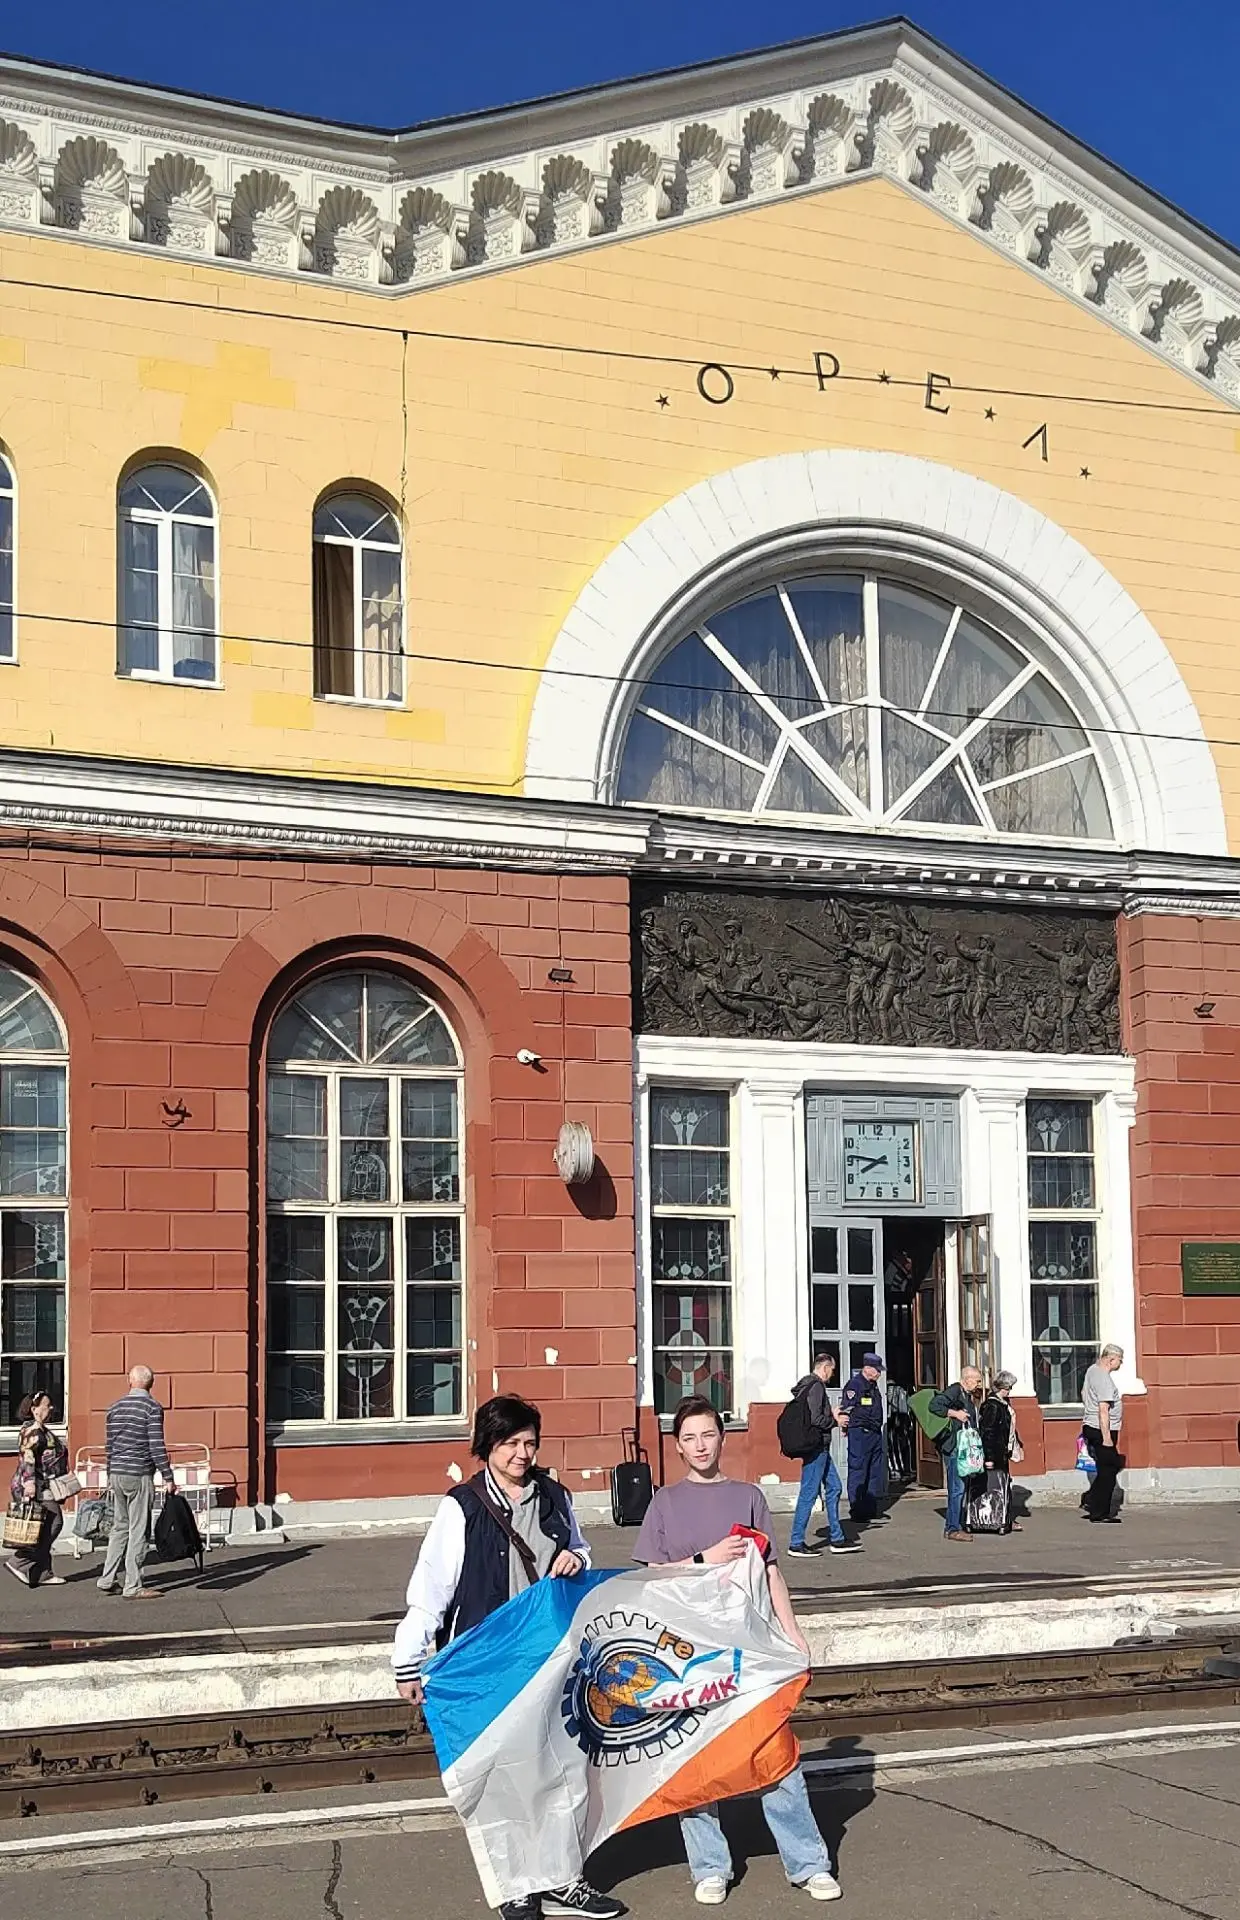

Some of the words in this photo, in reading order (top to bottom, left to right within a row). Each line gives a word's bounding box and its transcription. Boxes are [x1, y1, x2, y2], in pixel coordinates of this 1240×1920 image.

[858, 1124, 865, 1135] 11
[873, 1124, 883, 1136] 12
[892, 1124, 896, 1136] 1
[844, 1137, 854, 1149] 10
[903, 1138, 909, 1149] 2
[847, 1156, 854, 1166] 9
[903, 1156, 910, 1167] 3
[847, 1173, 854, 1184] 8
[904, 1174, 911, 1184] 4
[860, 1187, 865, 1197] 7
[876, 1187, 882, 1197] 6
[892, 1187, 899, 1197] 5
[658, 1630, 695, 1660] Fe
